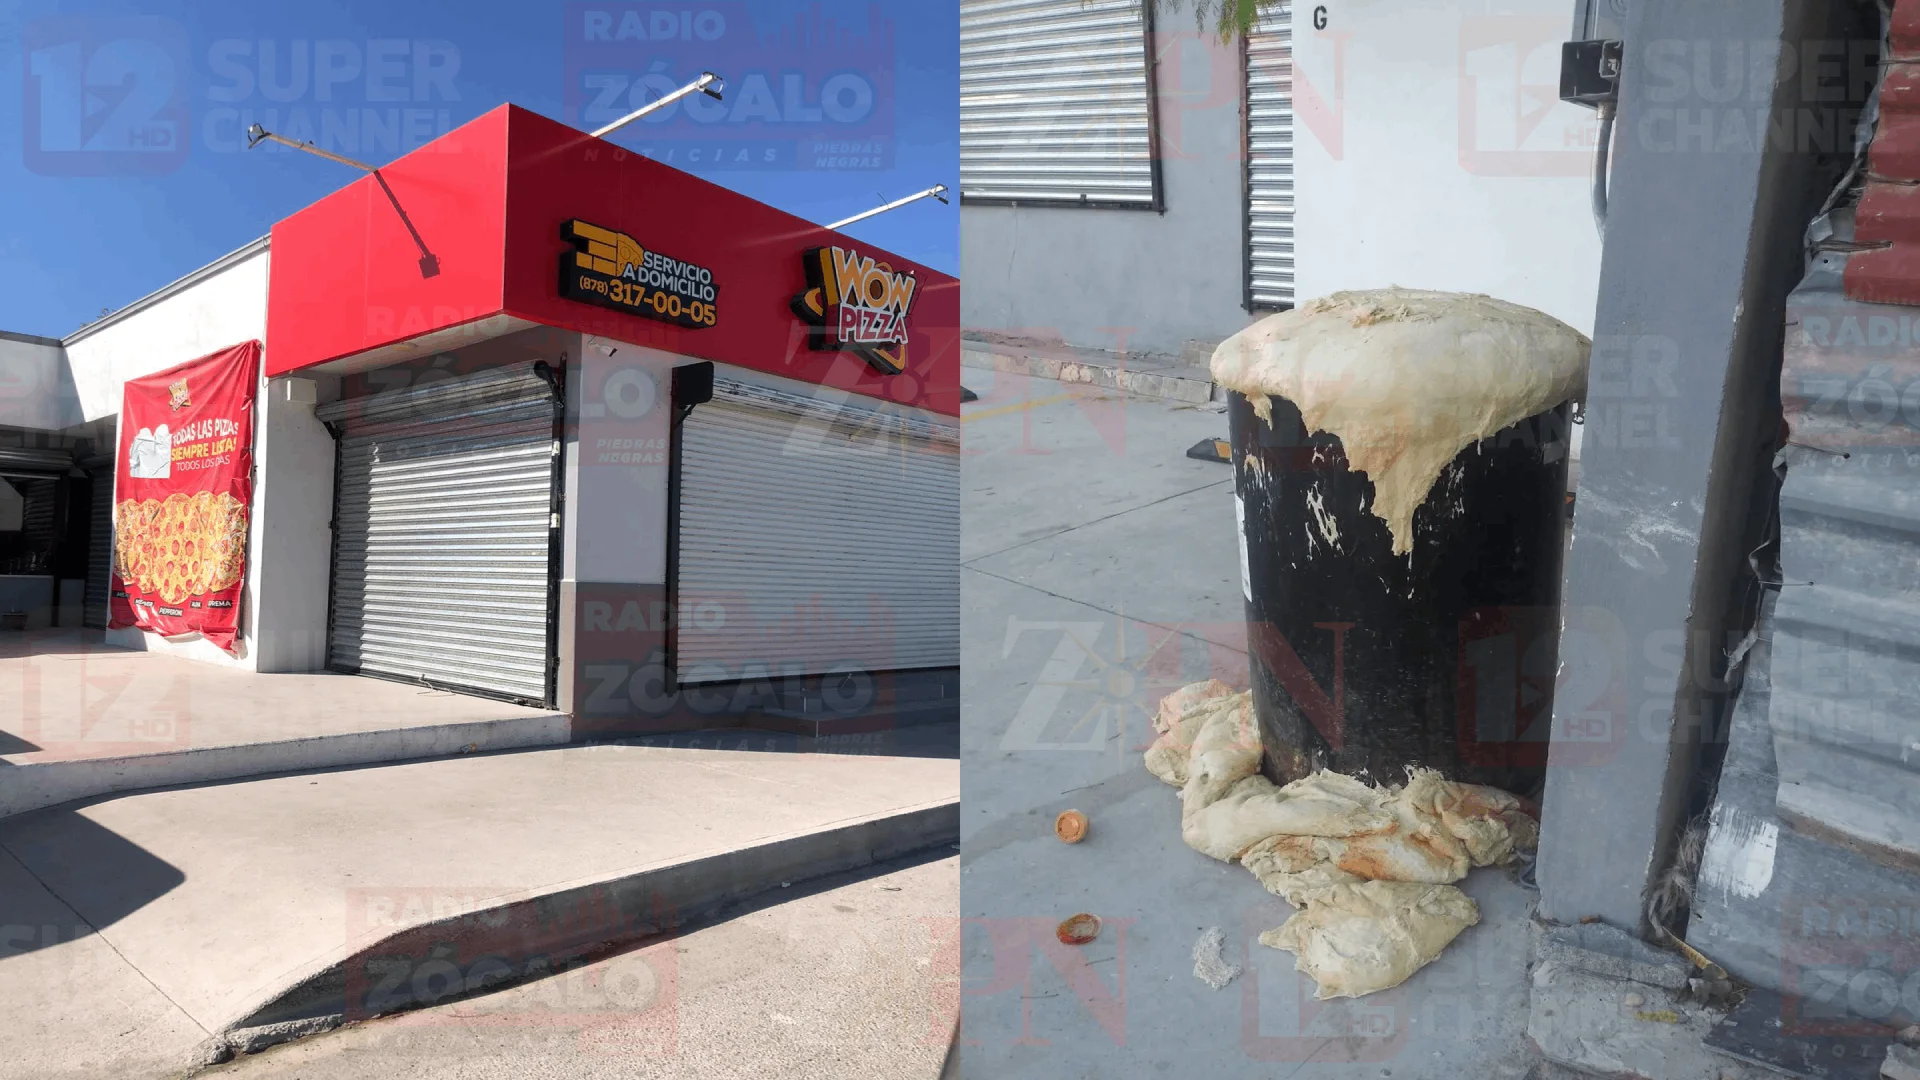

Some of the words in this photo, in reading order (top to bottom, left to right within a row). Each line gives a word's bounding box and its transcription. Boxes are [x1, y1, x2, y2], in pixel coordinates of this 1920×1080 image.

[1313, 5, 1328, 31] G
[622, 263, 636, 281] A
[638, 269, 715, 301] DOMICILIO
[643, 251, 712, 285] SERVICIO
[832, 246, 916, 317] WOW
[579, 275, 608, 296] (878)
[609, 279, 716, 326] 317-00-05
[838, 303, 909, 344] PIZZA
[173, 423, 196, 446] TODAS
[197, 419, 213, 439] LAS
[171, 442, 209, 461] SIEMPRE
[176, 460, 201, 471] TODOS
[201, 458, 214, 469] LOS
